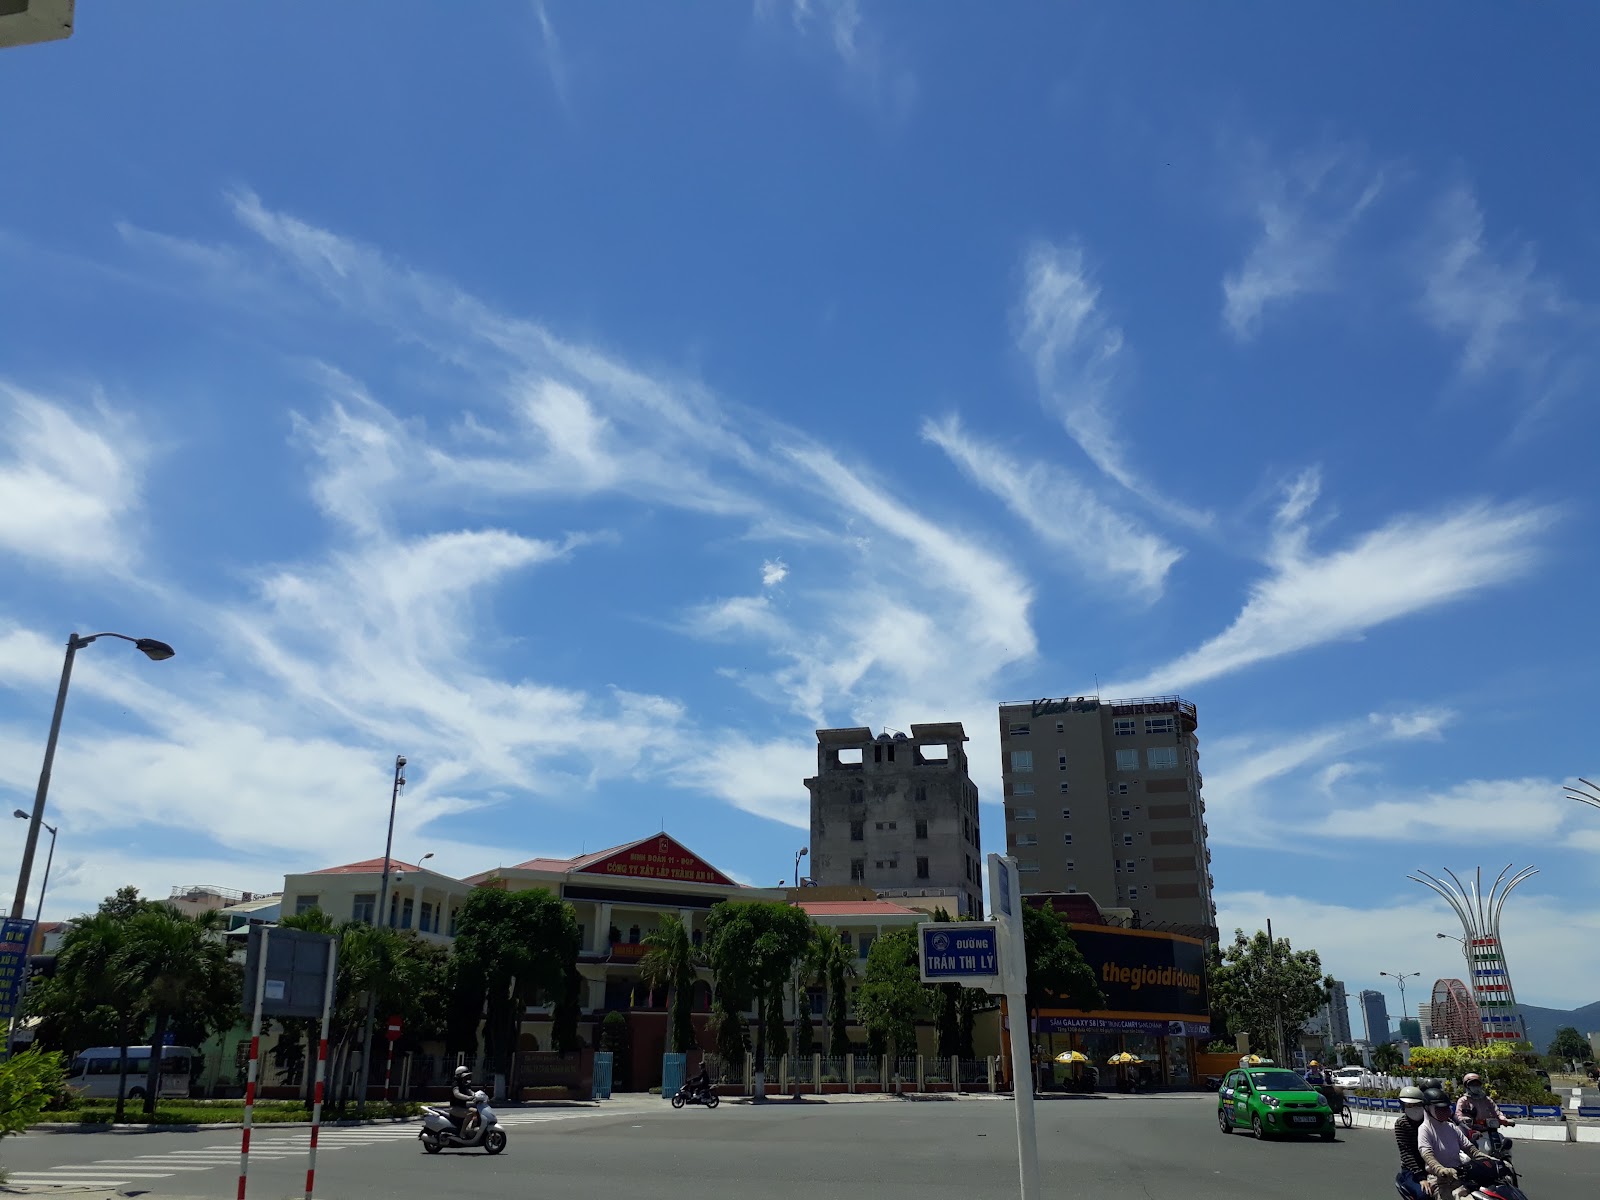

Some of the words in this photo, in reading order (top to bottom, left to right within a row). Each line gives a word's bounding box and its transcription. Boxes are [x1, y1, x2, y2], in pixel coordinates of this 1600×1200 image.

[956, 937, 989, 949] ĐƯỜNG
[927, 953, 956, 970] TRẦN
[959, 955, 976, 971] THỊ
[981, 952, 994, 969] LÝ
[1102, 961, 1200, 995] thegioididong
[1062, 1018, 1089, 1027] GALAXY
